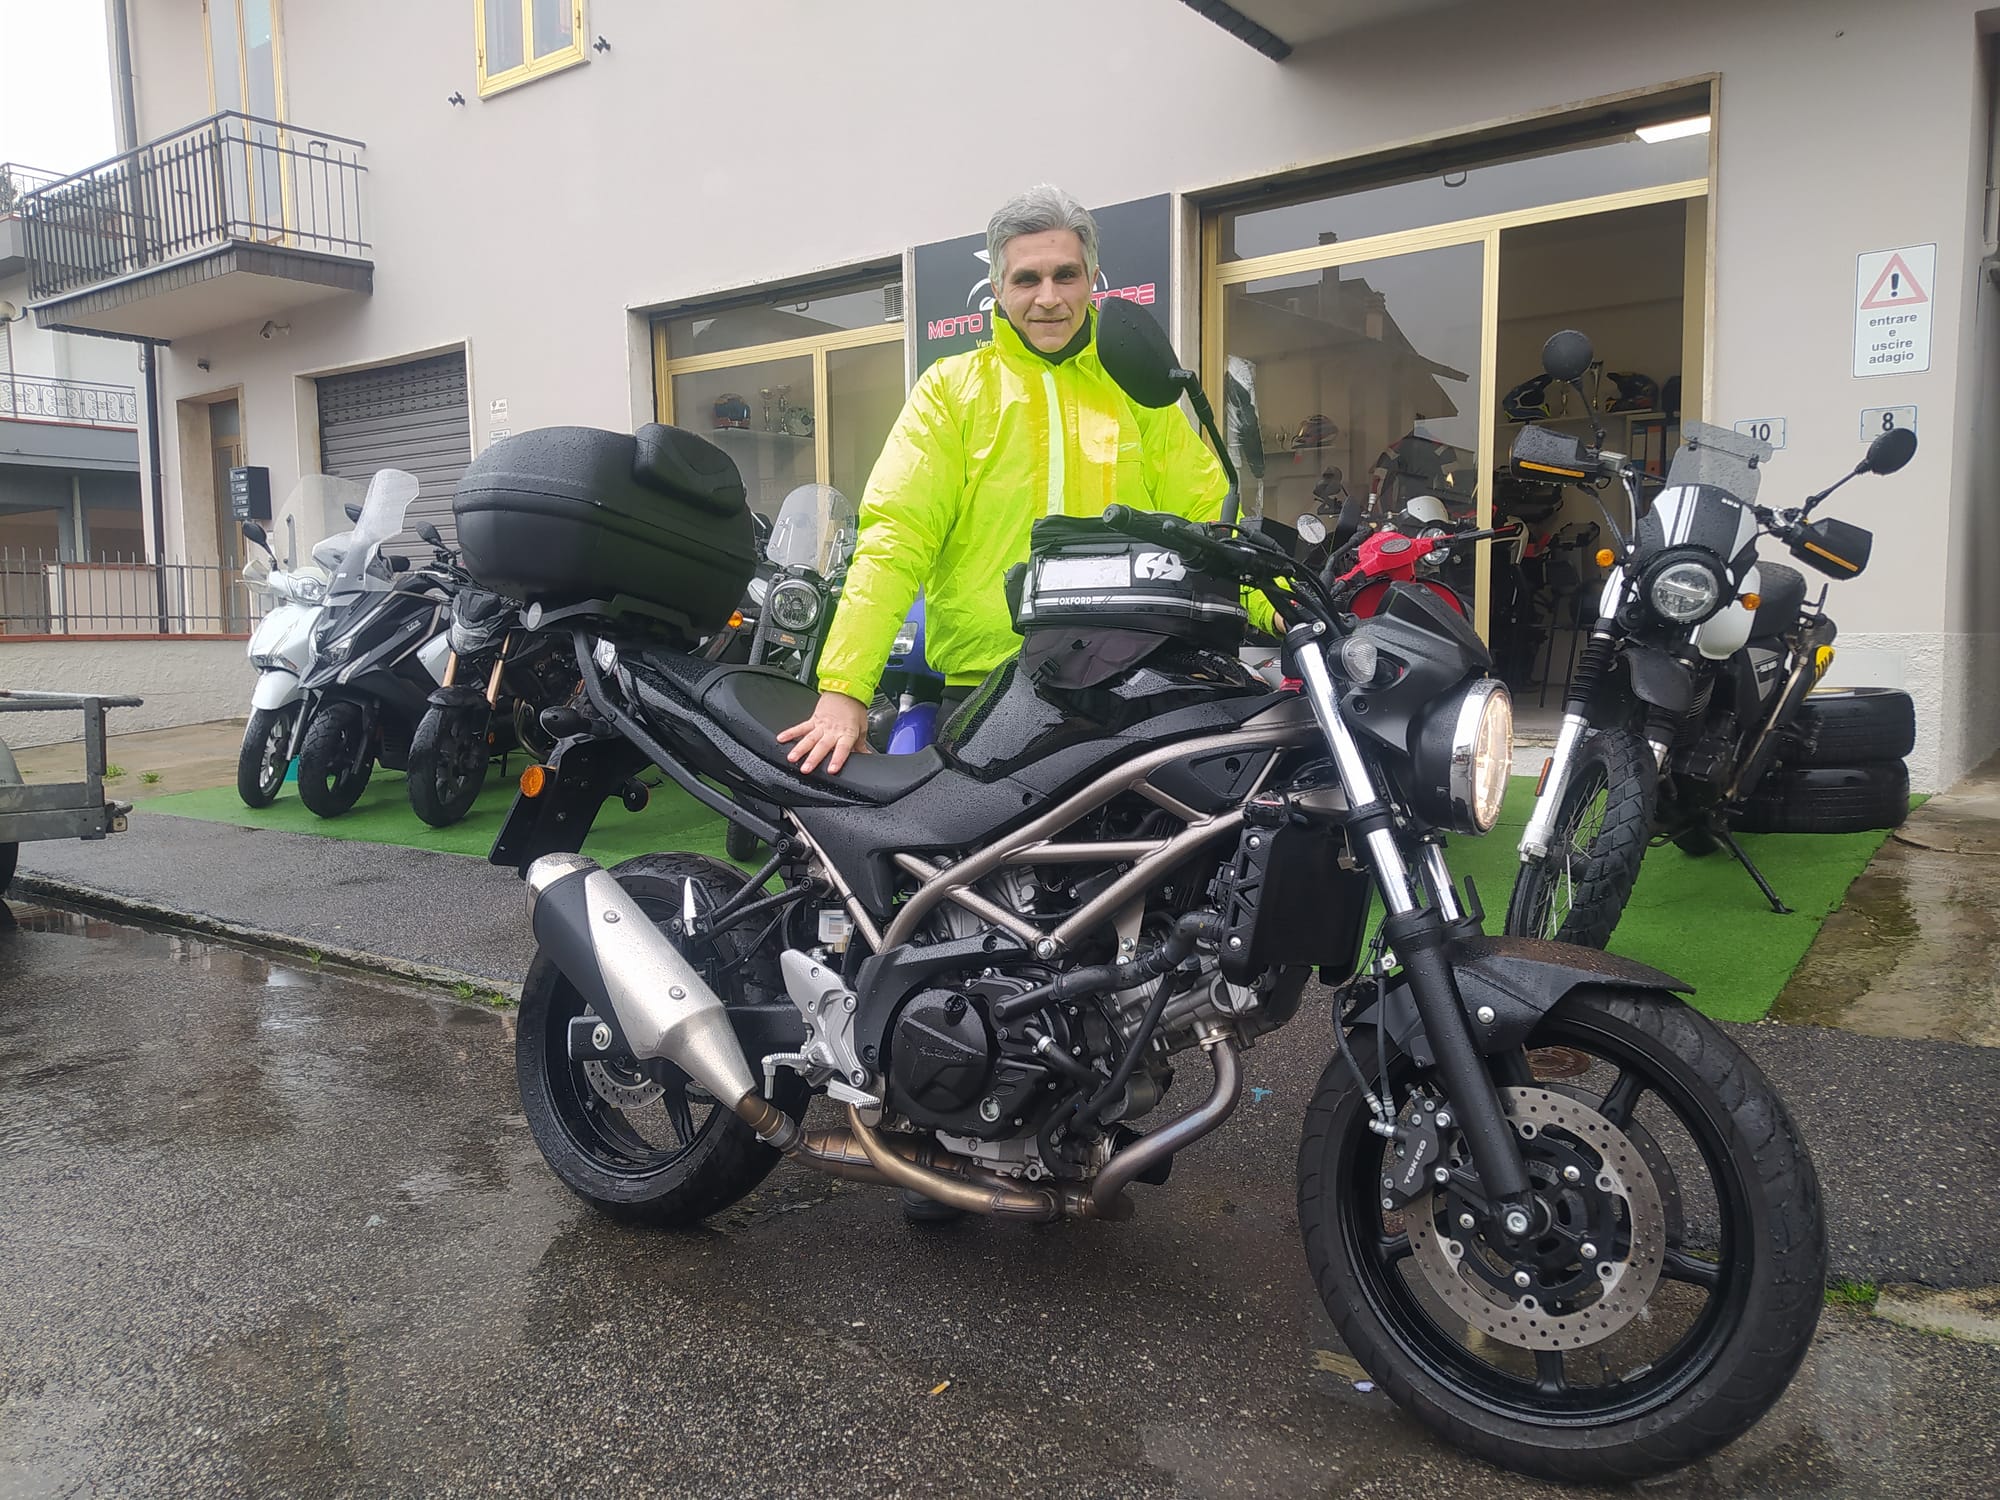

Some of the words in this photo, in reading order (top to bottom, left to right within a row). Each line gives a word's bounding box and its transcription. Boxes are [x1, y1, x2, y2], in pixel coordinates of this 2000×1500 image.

[928, 313, 983, 340] MOTO
[1869, 313, 1917, 327] entrare
[1888, 329, 1896, 337] e
[1872, 339, 1913, 352] uscire
[1869, 351, 1915, 365] adagio
[1882, 412, 1894, 431] 8
[1750, 424, 1770, 441] 10
[1058, 596, 1093, 605] OXFORD
[1403, 1139, 1427, 1184] TOKICO
